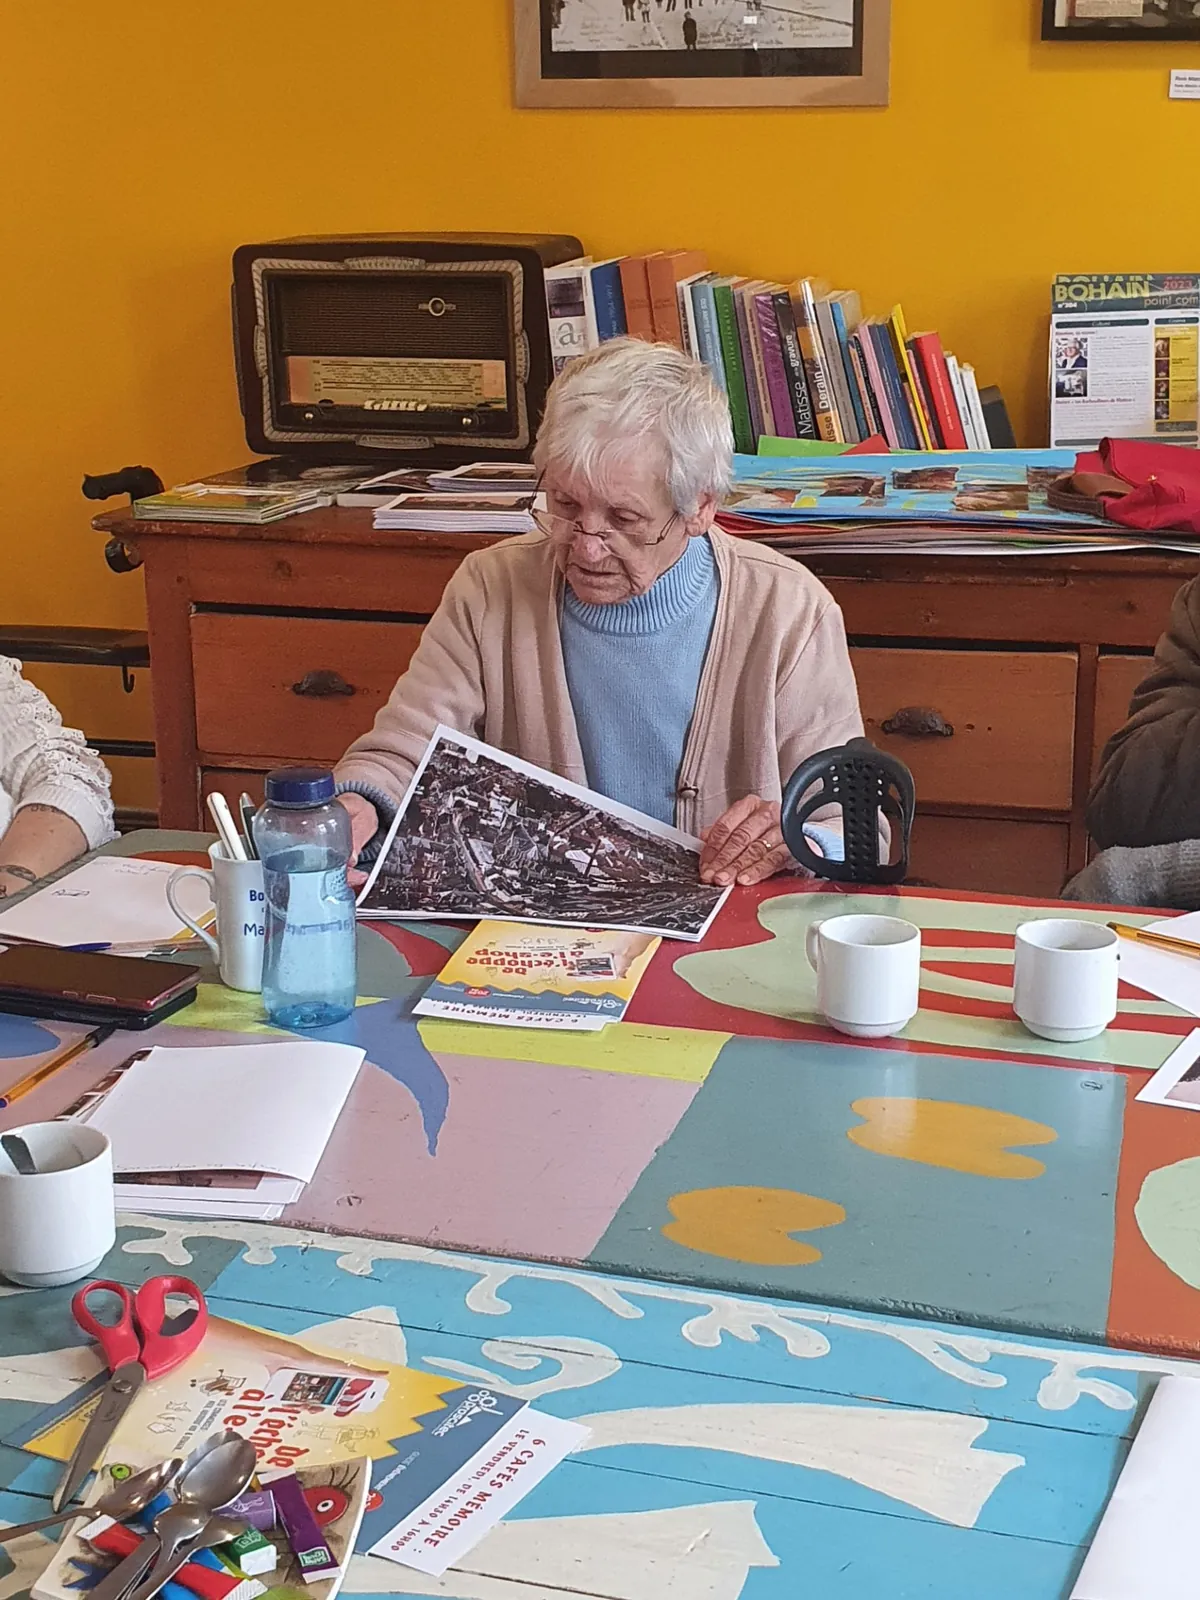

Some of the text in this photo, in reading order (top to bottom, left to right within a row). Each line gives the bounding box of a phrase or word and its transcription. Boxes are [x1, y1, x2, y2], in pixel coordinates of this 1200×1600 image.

[1055, 281, 1150, 302] BOHAIN
[1144, 295, 1172, 308] point
[786, 335, 800, 368] gravure
[814, 369, 830, 410] Derain
[794, 381, 813, 435] Matisse
[249, 890, 265, 901] Bo
[244, 923, 265, 936] Ma
[442, 1005, 511, 1021] MÉMOIRE
[514, 1429, 530, 1440] LE
[532, 1438, 546, 1446] 6
[468, 1441, 517, 1481] VENDREDI,
[489, 1450, 534, 1489] CAFÉS
[456, 1483, 472, 1495] DE
[429, 1496, 459, 1518] 14H30
[424, 1492, 493, 1547] MÉMOIRE
[391, 1528, 421, 1551] 16H00
